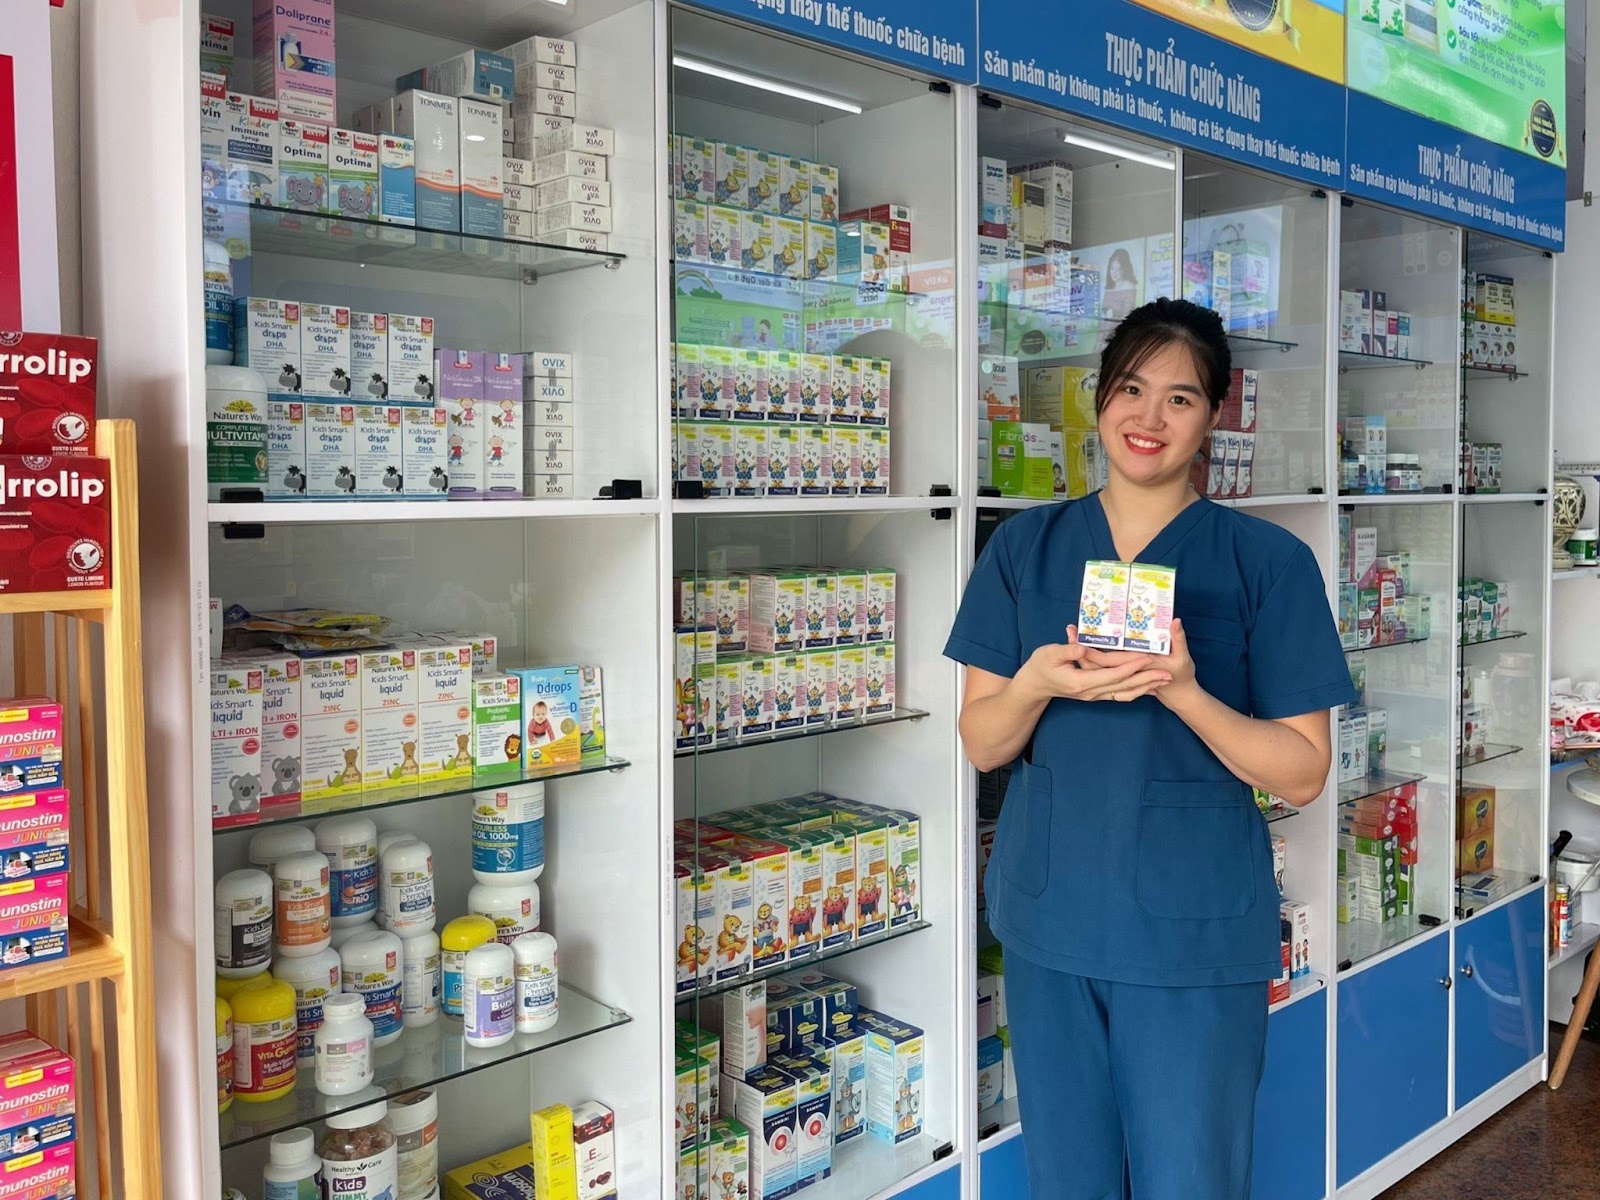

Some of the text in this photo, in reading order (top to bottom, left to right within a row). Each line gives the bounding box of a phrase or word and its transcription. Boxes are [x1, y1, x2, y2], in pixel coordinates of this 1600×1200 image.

[275, 5, 332, 27] Doliprane
[827, 4, 852, 32] thế
[854, 11, 893, 46] thuốc
[896, 26, 930, 57] chữa
[932, 35, 965, 67] bệnh
[547, 42, 565, 51] OVIX
[548, 68, 565, 77] OVIX
[1105, 31, 1261, 123] THỰC PHẨM CHỨC NĂNG
[547, 93, 564, 103] OVIX
[419, 97, 453, 111] TONIMER
[466, 107, 498, 119] TONIMER
[984, 49, 1341, 177] Sản phẩm này không phải là thuốc, không có tác dụng thay thế thuốc chữa bệnh
[238, 116, 271, 130] Kinder
[545, 119, 562, 127] OVIX
[230, 124, 270, 138] Immune
[241, 134, 260, 143] Syrup
[284, 145, 323, 159] Optima
[335, 155, 373, 169] Optima
[506, 161, 524, 170] OVIX
[1350, 163, 1365, 183] Sản
[1418, 143, 1515, 204] THỰC PHẨM CHỨC NĂNG
[504, 187, 521, 196] OVIX
[254, 320, 270, 329] Kids
[307, 326, 323, 335] Kids
[394, 334, 409, 343] Kids
[266, 340, 284, 349] DHA
[317, 344, 335, 353] DHA
[356, 350, 372, 359] DHA
[403, 352, 419, 360] DHA
[542, 358, 566, 368] OVIX
[541, 386, 565, 396] OVIX
[213, 411, 263, 423] Nature's Way
[312, 425, 328, 434] Kids
[360, 426, 375, 435] Kids
[408, 428, 423, 436] Kids
[999, 429, 1037, 443] Fibradis
[271, 442, 289, 450] DHA
[371, 444, 386, 452] DHA
[427, 669, 443, 678] Kids
[311, 680, 328, 689] Kids
[371, 675, 388, 684] Kids
[435, 678, 458, 688] liquid
[379, 684, 403, 695] liquid
[537, 682, 572, 695] Ddrops
[320, 689, 344, 702] liquid
[437, 692, 455, 700] ZINC
[262, 698, 283, 711] quid
[382, 699, 401, 707] ZINC
[570, 702, 577, 713] D
[322, 705, 342, 713] ZINC
[486, 707, 511, 715] Probiotic
[212, 710, 244, 724] liquid
[276, 712, 298, 722] IRON
[235, 727, 259, 736] IRON
[491, 816, 505, 824] Way
[489, 832, 519, 841] 1000mg
[287, 900, 325, 911] Kids Smart
[511, 925, 525, 934] Way
[353, 978, 394, 991] Nature's Way
[372, 989, 396, 1001] Smart
[331, 1159, 382, 1173] Healthy Care
[335, 1178, 364, 1191] kids
